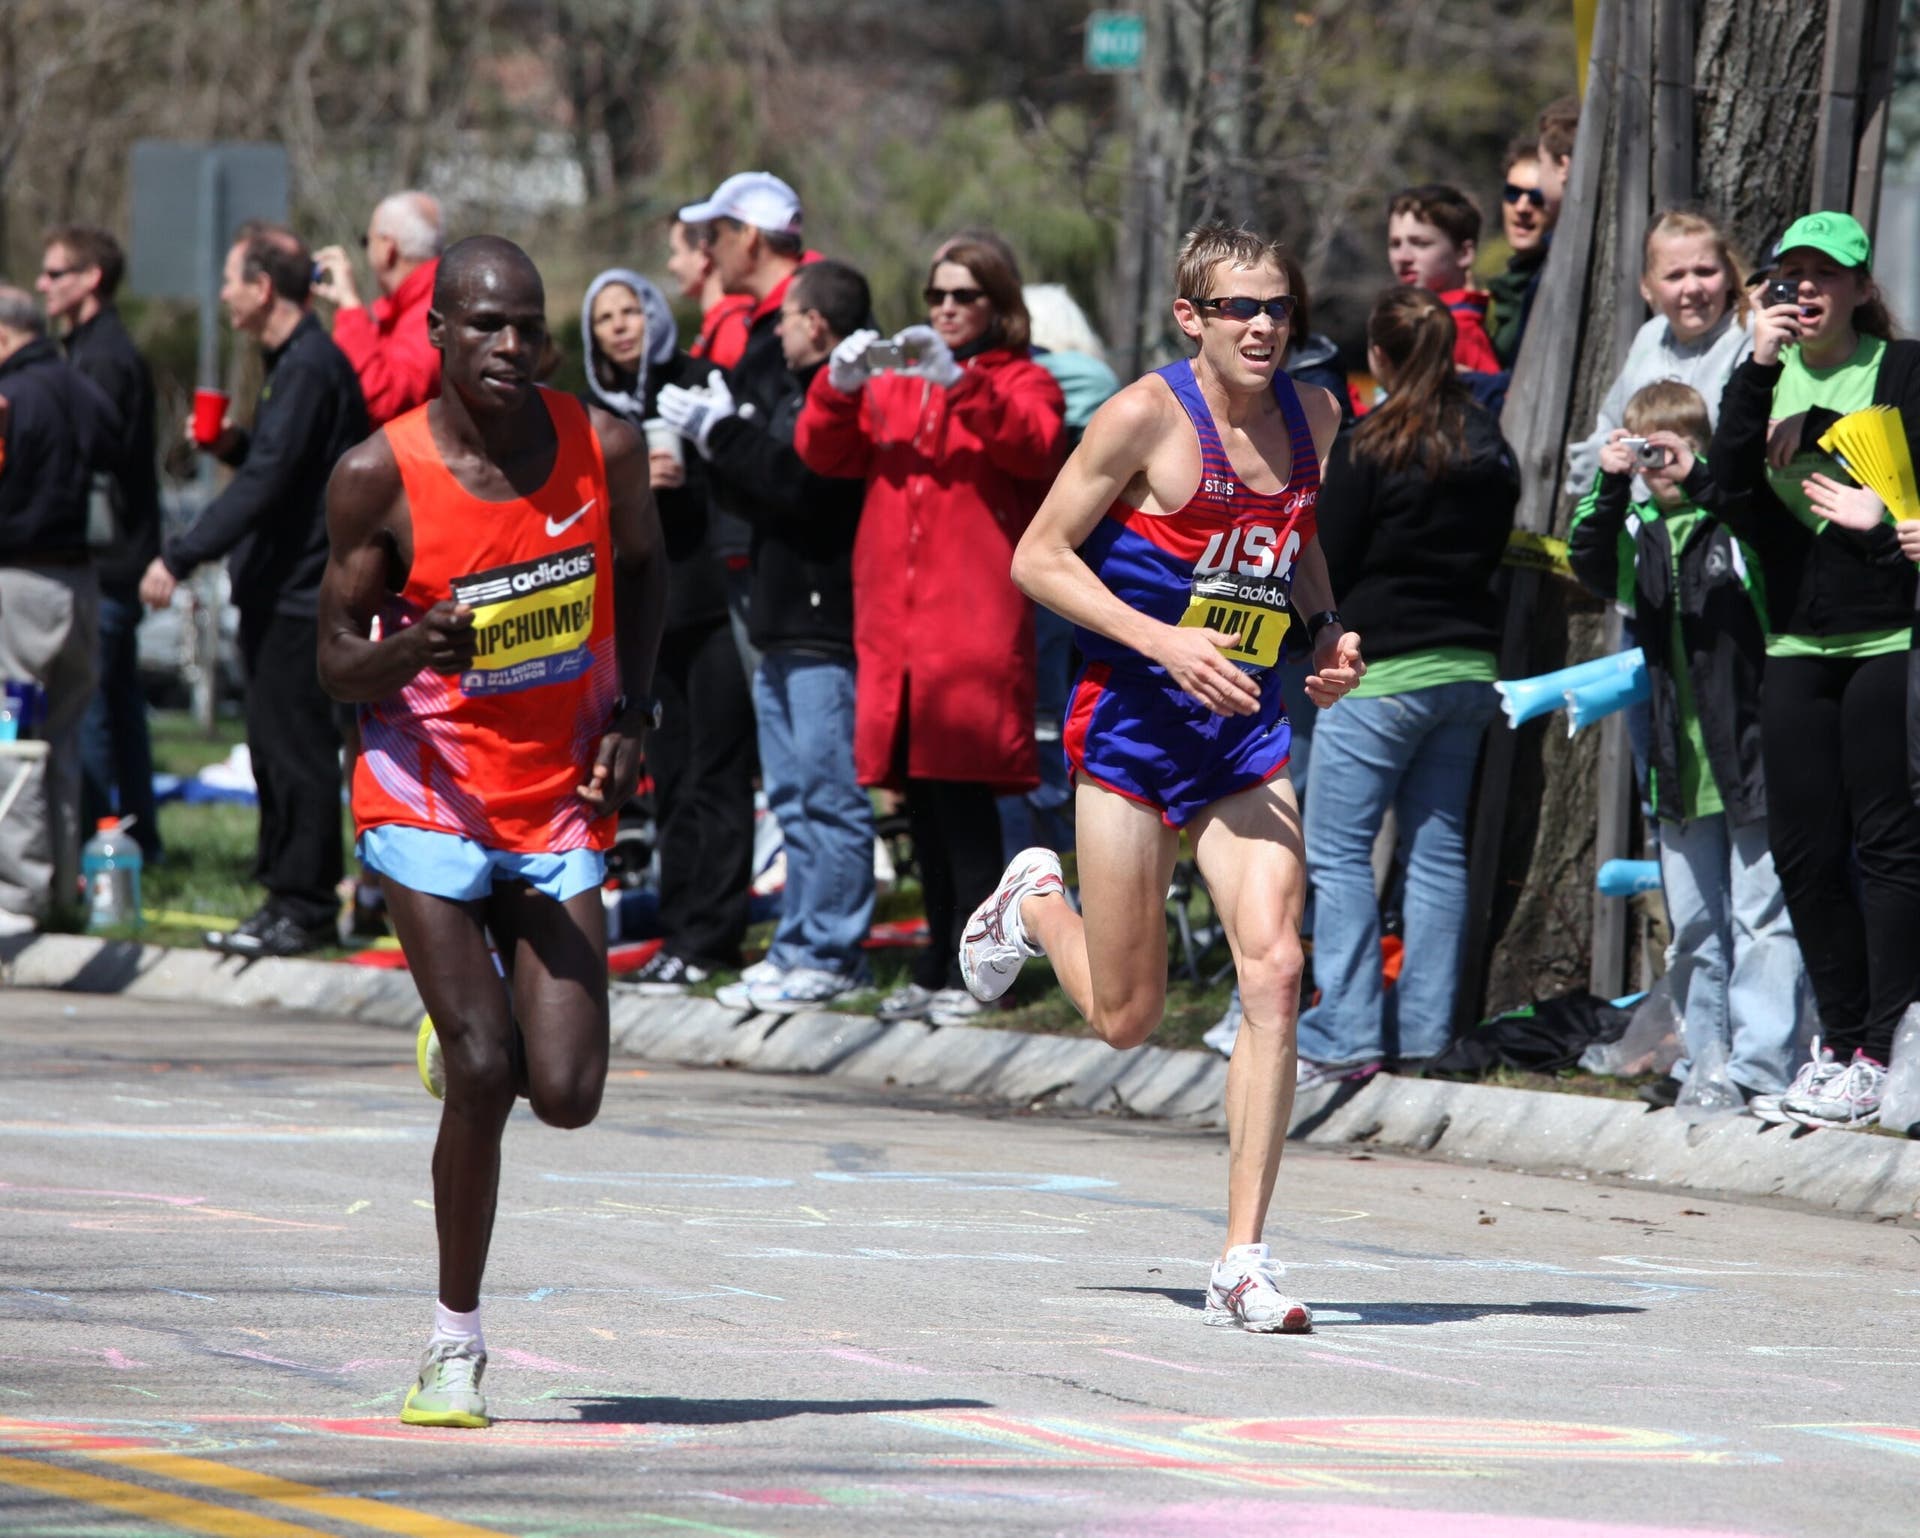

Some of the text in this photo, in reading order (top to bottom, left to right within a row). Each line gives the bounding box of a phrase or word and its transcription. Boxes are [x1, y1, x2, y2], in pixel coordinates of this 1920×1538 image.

[1193, 525, 1301, 582] USA
[512, 556, 591, 591] adidas
[1203, 605, 1265, 656] HALL
[486, 669, 547, 687] MARATHON
[510, 660, 547, 677] BOSTON
